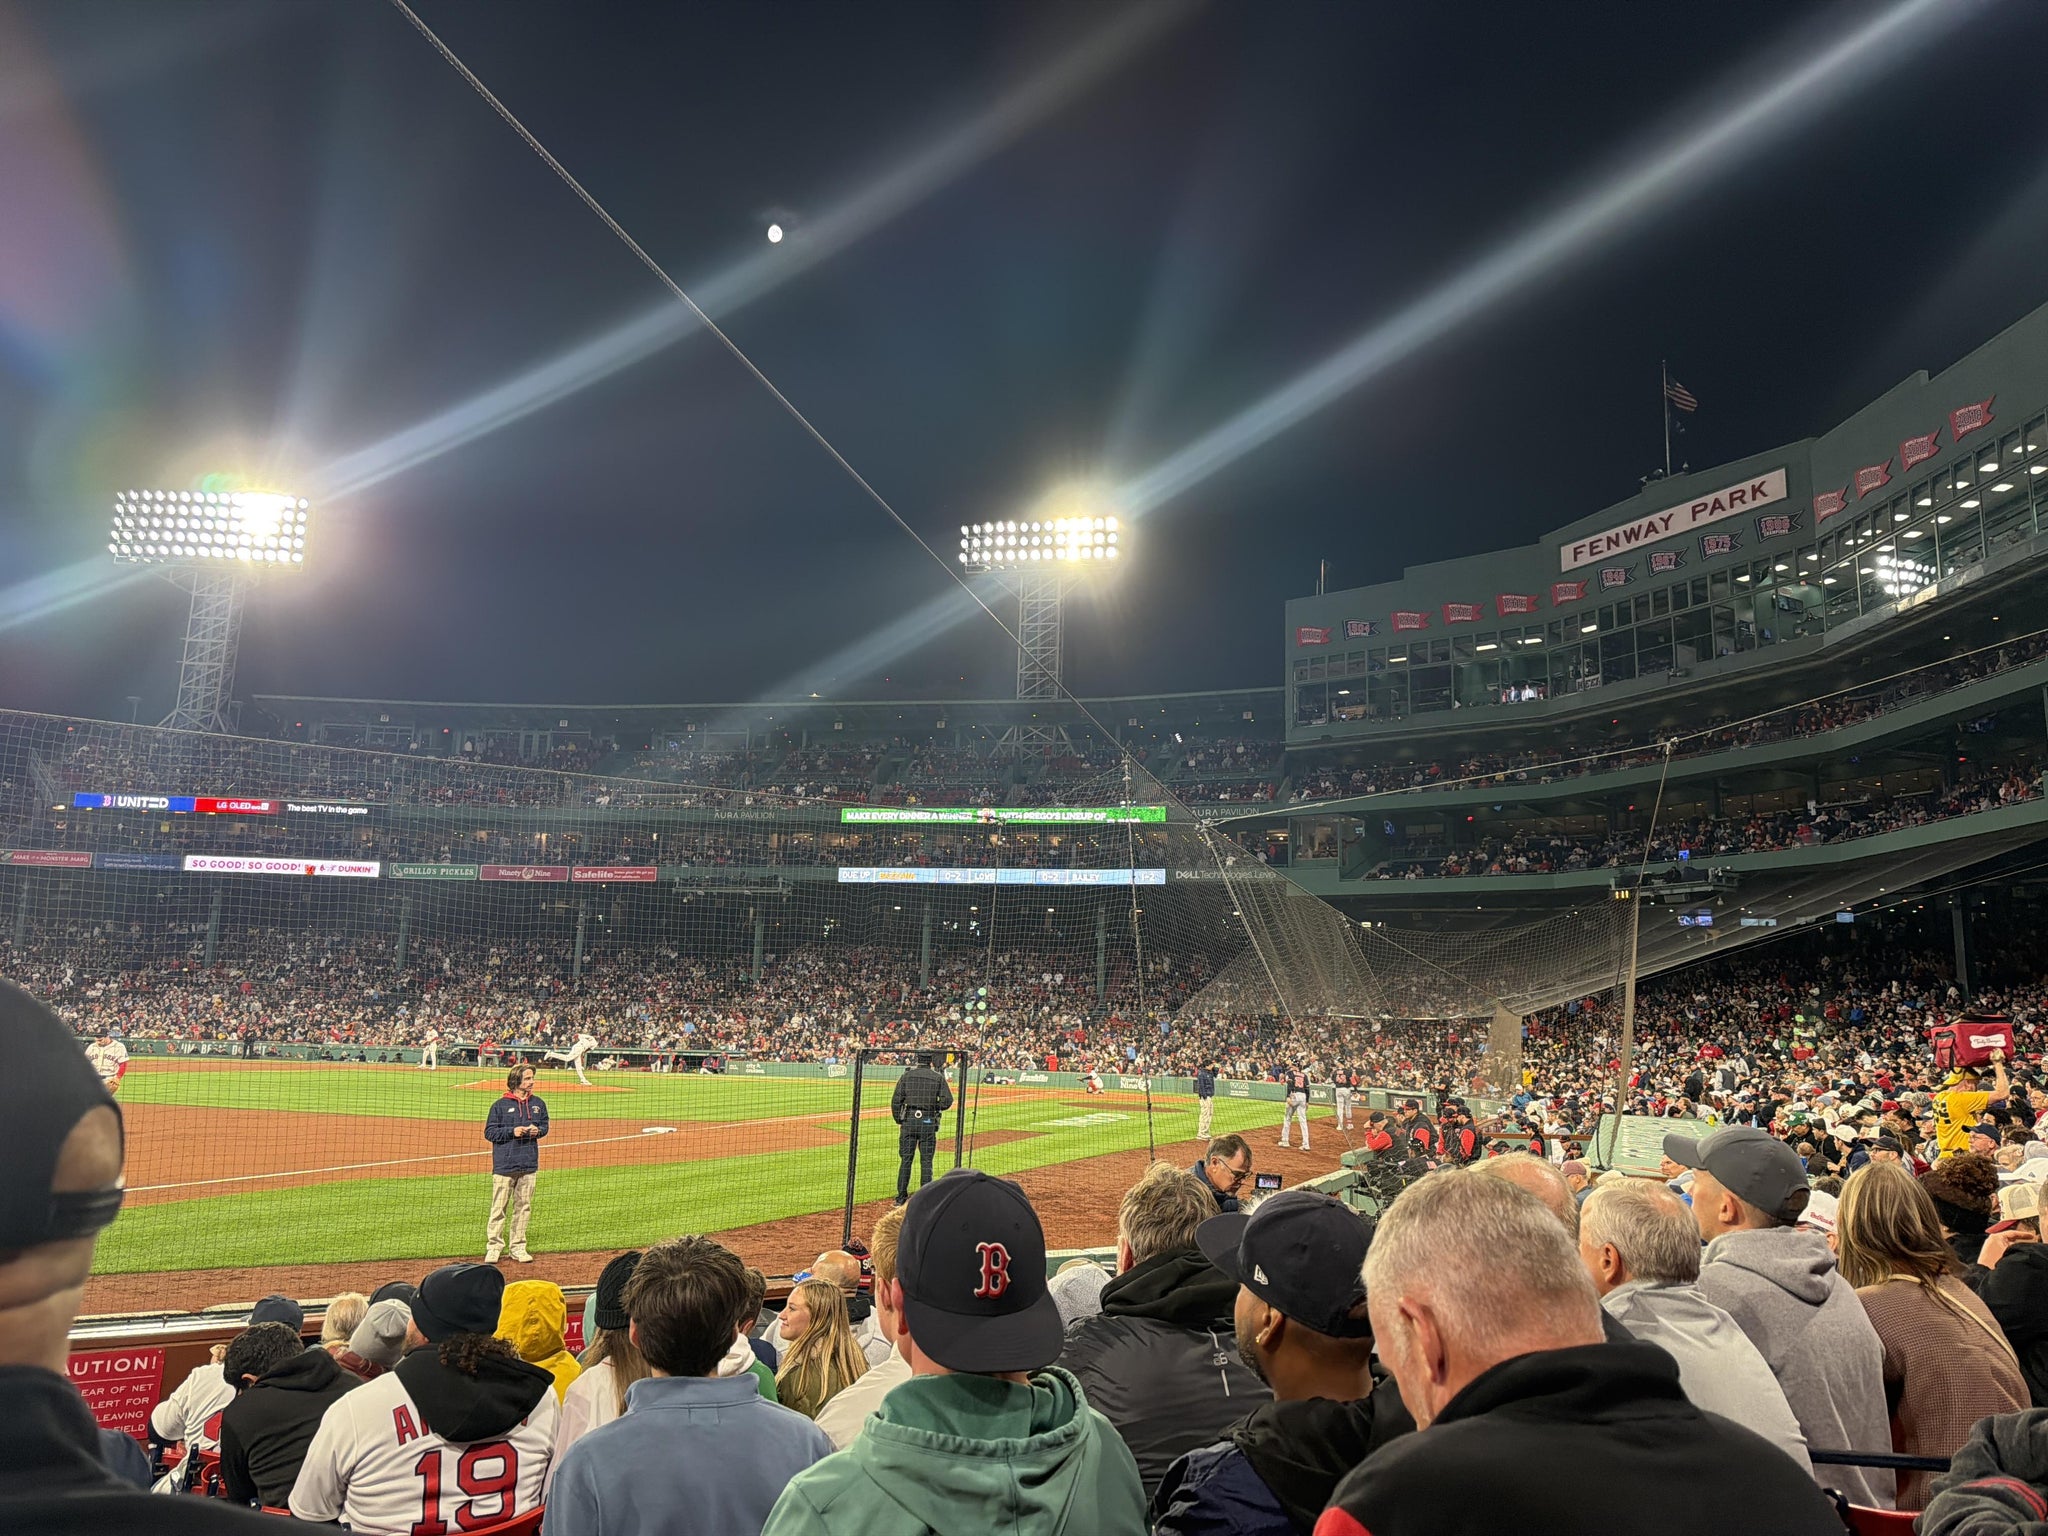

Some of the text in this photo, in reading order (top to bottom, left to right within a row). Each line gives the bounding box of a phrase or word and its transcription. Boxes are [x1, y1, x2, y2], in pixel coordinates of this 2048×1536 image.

[1573, 513, 1674, 562] FENWAY
[1691, 481, 1768, 521] PARK
[1704, 537, 1730, 551] 1975
[1651, 556, 1676, 568] 1967
[117, 796, 169, 809] UNITED
[740, 811, 775, 819] PAVILION
[846, 812, 871, 820] MAKE
[872, 812, 898, 820] EVERY
[899, 812, 930, 820] DINNER
[939, 812, 972, 820] WINNER
[1094, 812, 1106, 820] OF
[1220, 808, 1259, 816] PAVILION
[192, 860, 301, 871] SO GOOD! SO GOOD!
[440, 868, 474, 876] PICKLES
[574, 870, 614, 879] Safelite
[1175, 870, 1200, 879] DELL
[1019, 1072, 1048, 1082] Franklin
[973, 1242, 1011, 1298] B
[81, 1383, 154, 1397] EAR OF NET
[125, 1397, 149, 1406] FOR
[95, 1411, 144, 1422] LEAVING
[411, 1440, 518, 1536] 19
